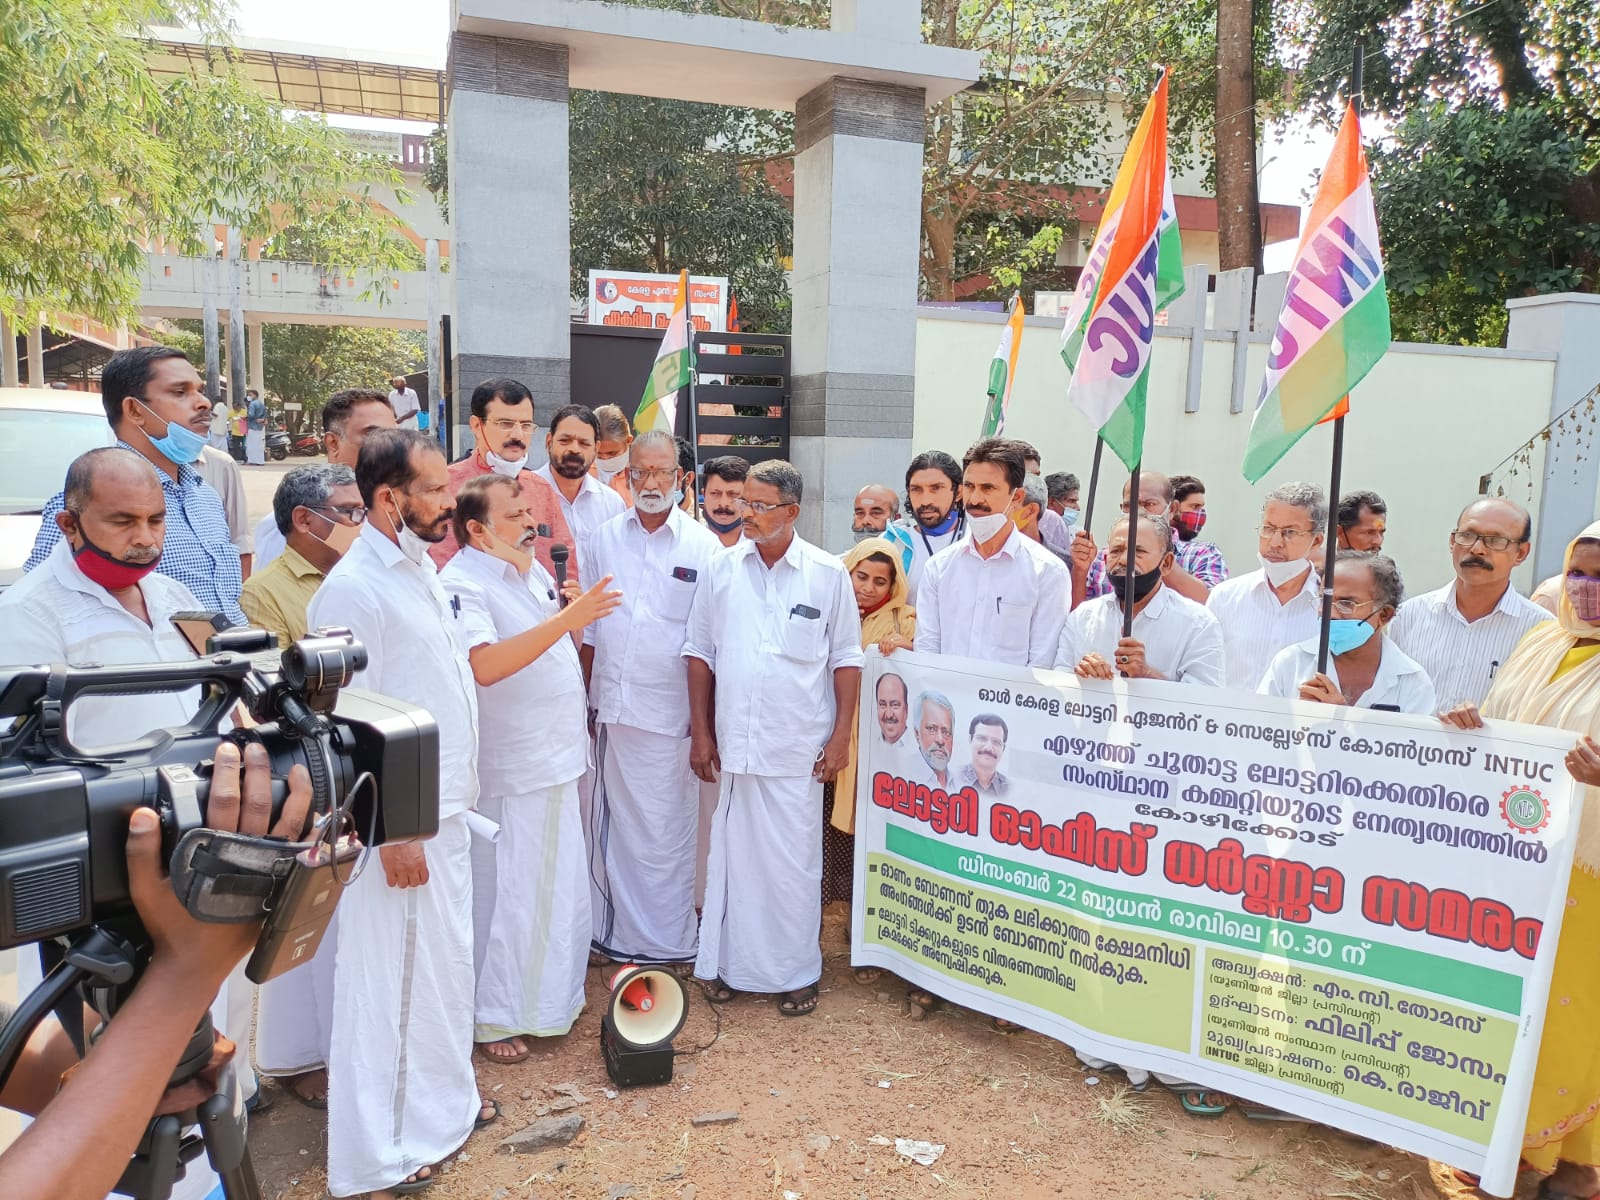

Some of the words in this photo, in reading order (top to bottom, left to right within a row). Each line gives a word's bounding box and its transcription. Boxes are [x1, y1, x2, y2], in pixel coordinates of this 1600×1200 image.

[978, 688, 1010, 704] ഓൾ
[1015, 694, 1060, 717] കേരള
[1064, 701, 1118, 724] ലോട്ടറി
[1205, 718, 1219, 734] &
[1225, 722, 1336, 750] സെല്ലേഴ്സ്
[1339, 736, 1477, 766] കോൺഗ്രസ്
[1483, 752, 1554, 783] INTUC
[1043, 735, 1142, 765] എഴുത്ത്
[1144, 750, 1238, 784] ചൂതാട്ട
[1247, 763, 1490, 817] ലോട്ടറിക്കെതിരെ
[1135, 803, 1344, 847] കോഴിക്കോട്
[1181, 784, 1342, 826] കമ്മറ്റിയുടെ
[1352, 810, 1548, 864] നേതൃത്വത്തിൽ
[872, 771, 979, 836] ലോട്ടറി
[990, 803, 1158, 877] ഓഫീസ്
[1163, 837, 1346, 924] ധർണ്ണാ
[1361, 875, 1543, 960] സമരം
[878, 907, 908, 930] ലോട്ടറി
[909, 918, 979, 959] ടിക്കറ്റുകളുടെ
[982, 947, 1076, 992] വിതരണത്തിലെ
[880, 882, 955, 925] അംഗങ്ങൾക്ക്
[957, 913, 989, 937] ഉടൻ
[993, 925, 1067, 960] ബോണസ്
[1069, 948, 1148, 985] നൽകുക.
[881, 863, 912, 887] ഓണം
[915, 876, 974, 909] ബോണസ്
[975, 897, 1010, 921] തുക
[1014, 908, 1090, 947] ലഭിക്കാത്ത
[1095, 934, 1191, 970] ക്ഷേമനിധി
[957, 854, 1050, 893] ഡിസംബർ
[1056, 879, 1077, 902] 22
[1081, 889, 1162, 922] ബുധൻ
[1169, 908, 1261, 943] രാവിലെ
[1269, 927, 1333, 958] 10.30
[1341, 942, 1372, 966] ന്
[878, 924, 921, 953] ക്രമക്കേട്
[921, 944, 1007, 987] അന്വേഷിക്കുക.
[1208, 994, 1298, 1025] ഉദ്ഘാടനം:
[1305, 1014, 1403, 1052] ഫിലിപ്പ്
[1277, 989, 1308, 1006] ജില്ലാ
[1205, 1045, 1240, 1063] (INTUC
[1244, 1057, 1274, 1074] ജില്ലാ
[1274, 1031, 1336, 1056] സംസ്ഥാന
